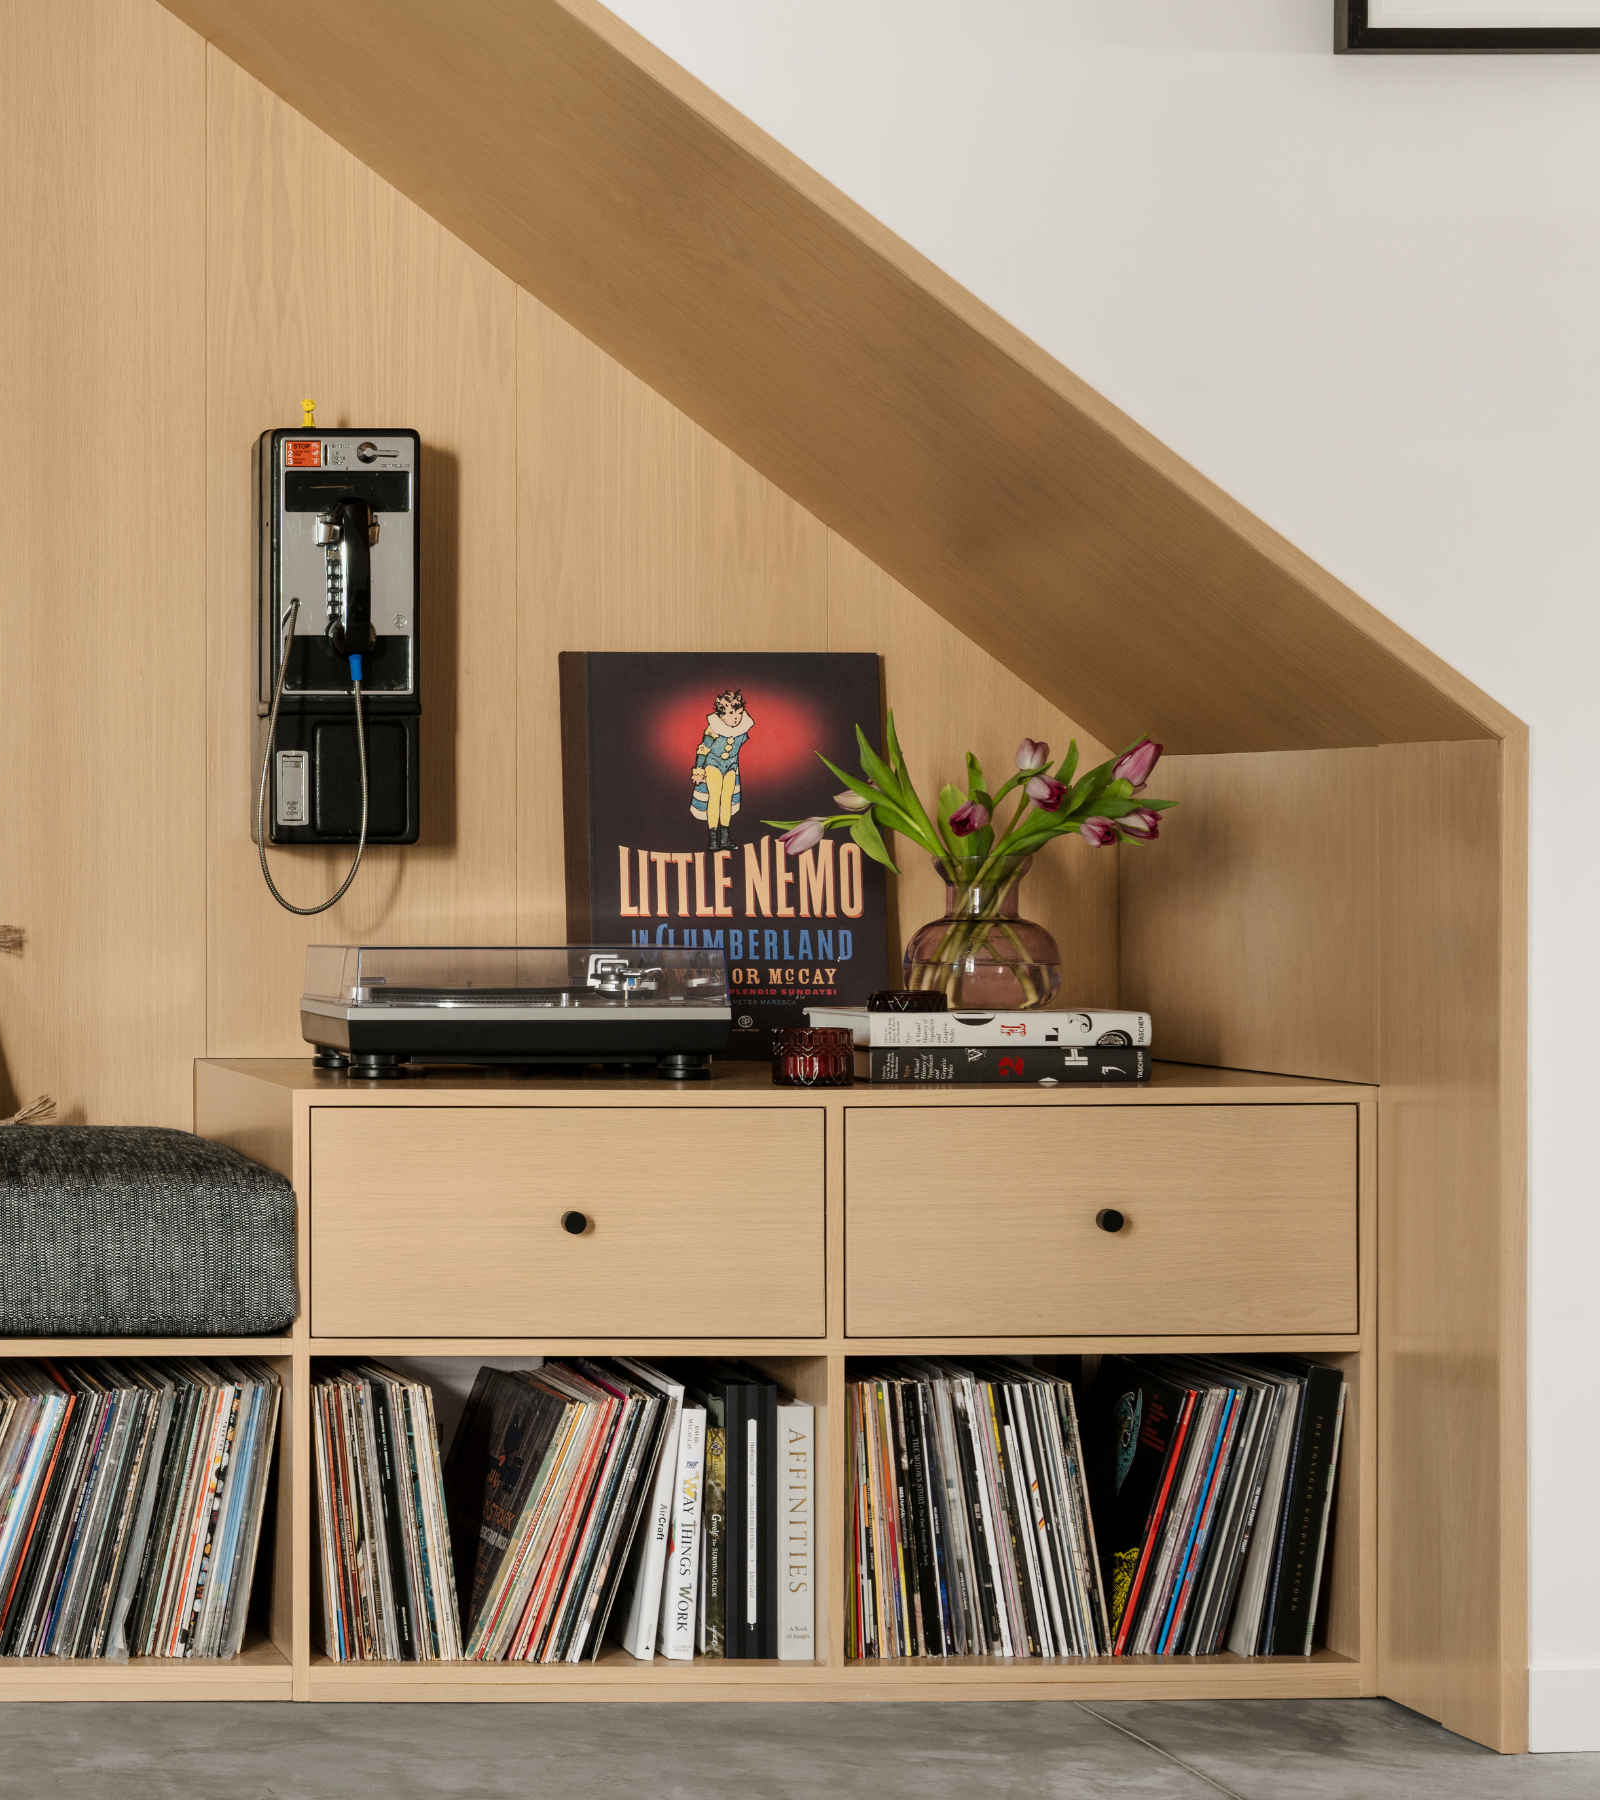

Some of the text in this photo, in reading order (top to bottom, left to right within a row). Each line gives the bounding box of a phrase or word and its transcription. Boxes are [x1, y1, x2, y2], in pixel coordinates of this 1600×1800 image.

[618, 834, 864, 919] LITTLE NEMO
[768, 968, 837, 985] McCAY
[903, 1065, 911, 1078] Type
[682, 1472, 700, 1515] WAY
[912, 1438, 925, 1505] THE MOTOWN STORY
[656, 1503, 668, 1541] AirCraft
[789, 1428, 808, 1593] AFFINITIES
[1291, 1415, 1323, 1612] THE VOYAGER GOLDEN RECORD
[679, 1521, 698, 1576] THINGS
[709, 1514, 723, 1597] Gwelf SURVIVAL GUIDE
[676, 1583, 693, 1631] WORK
